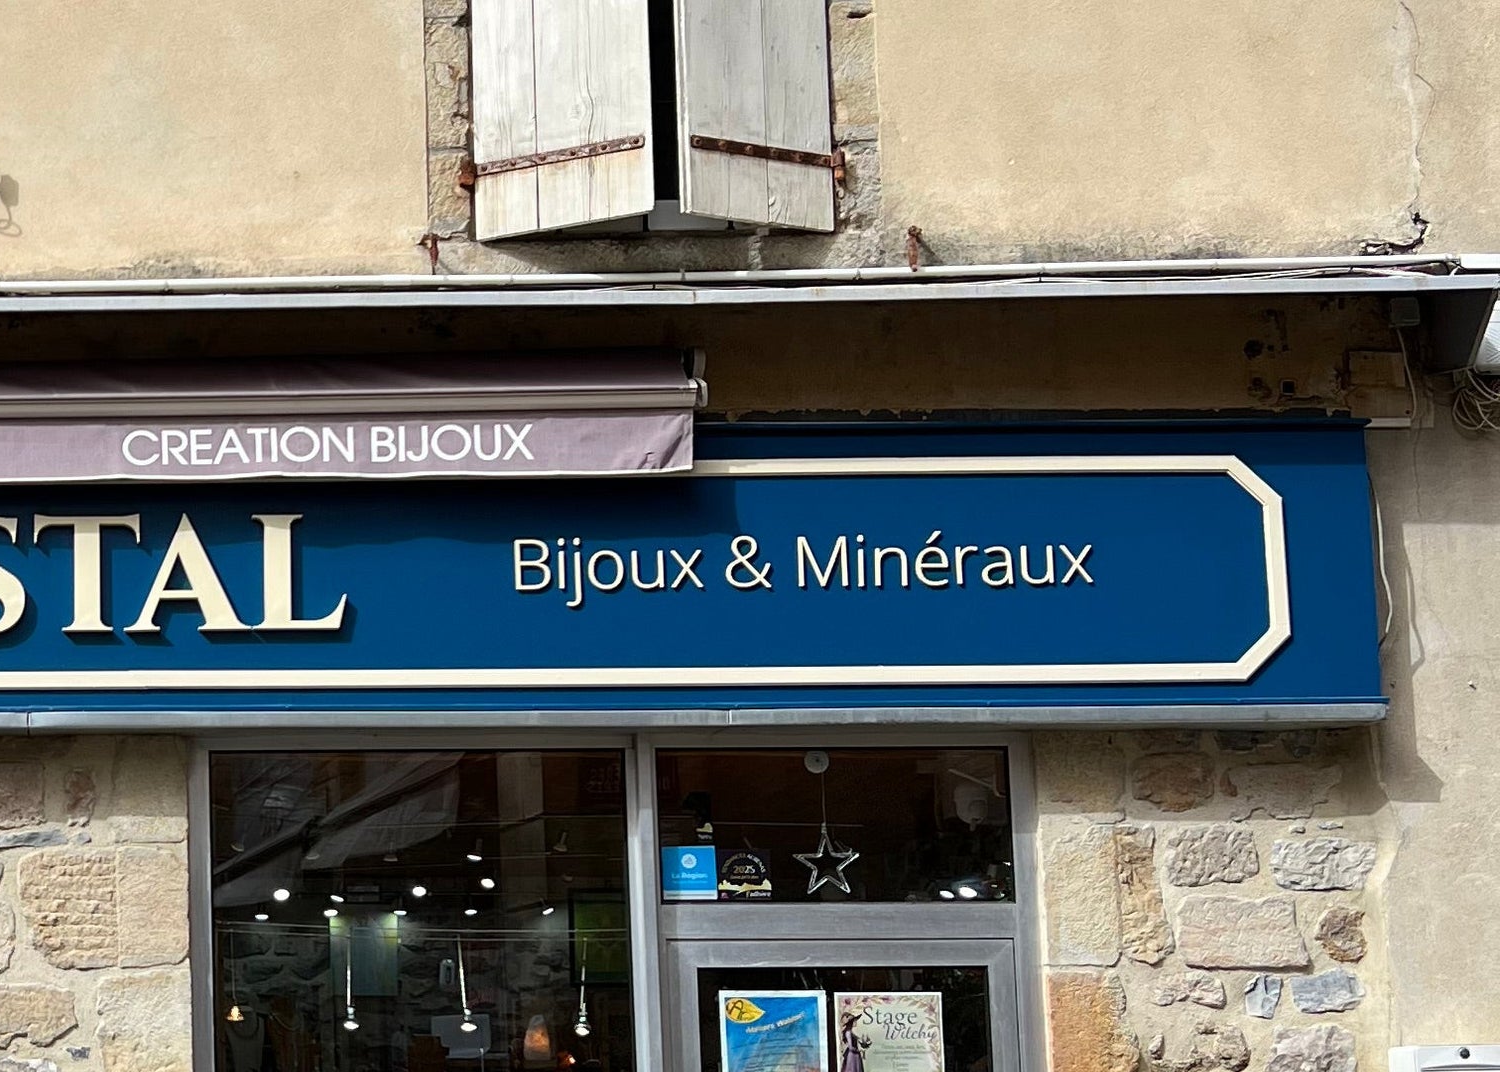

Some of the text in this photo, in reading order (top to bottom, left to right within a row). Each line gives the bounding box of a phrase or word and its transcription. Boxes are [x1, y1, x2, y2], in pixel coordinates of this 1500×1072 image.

[121, 423, 535, 466] CREATION BIJOUX
[512, 529, 1096, 608] Bijoux & Minéraux
[863, 1005, 918, 1032] Stage
[882, 1023, 938, 1041] Witchy
